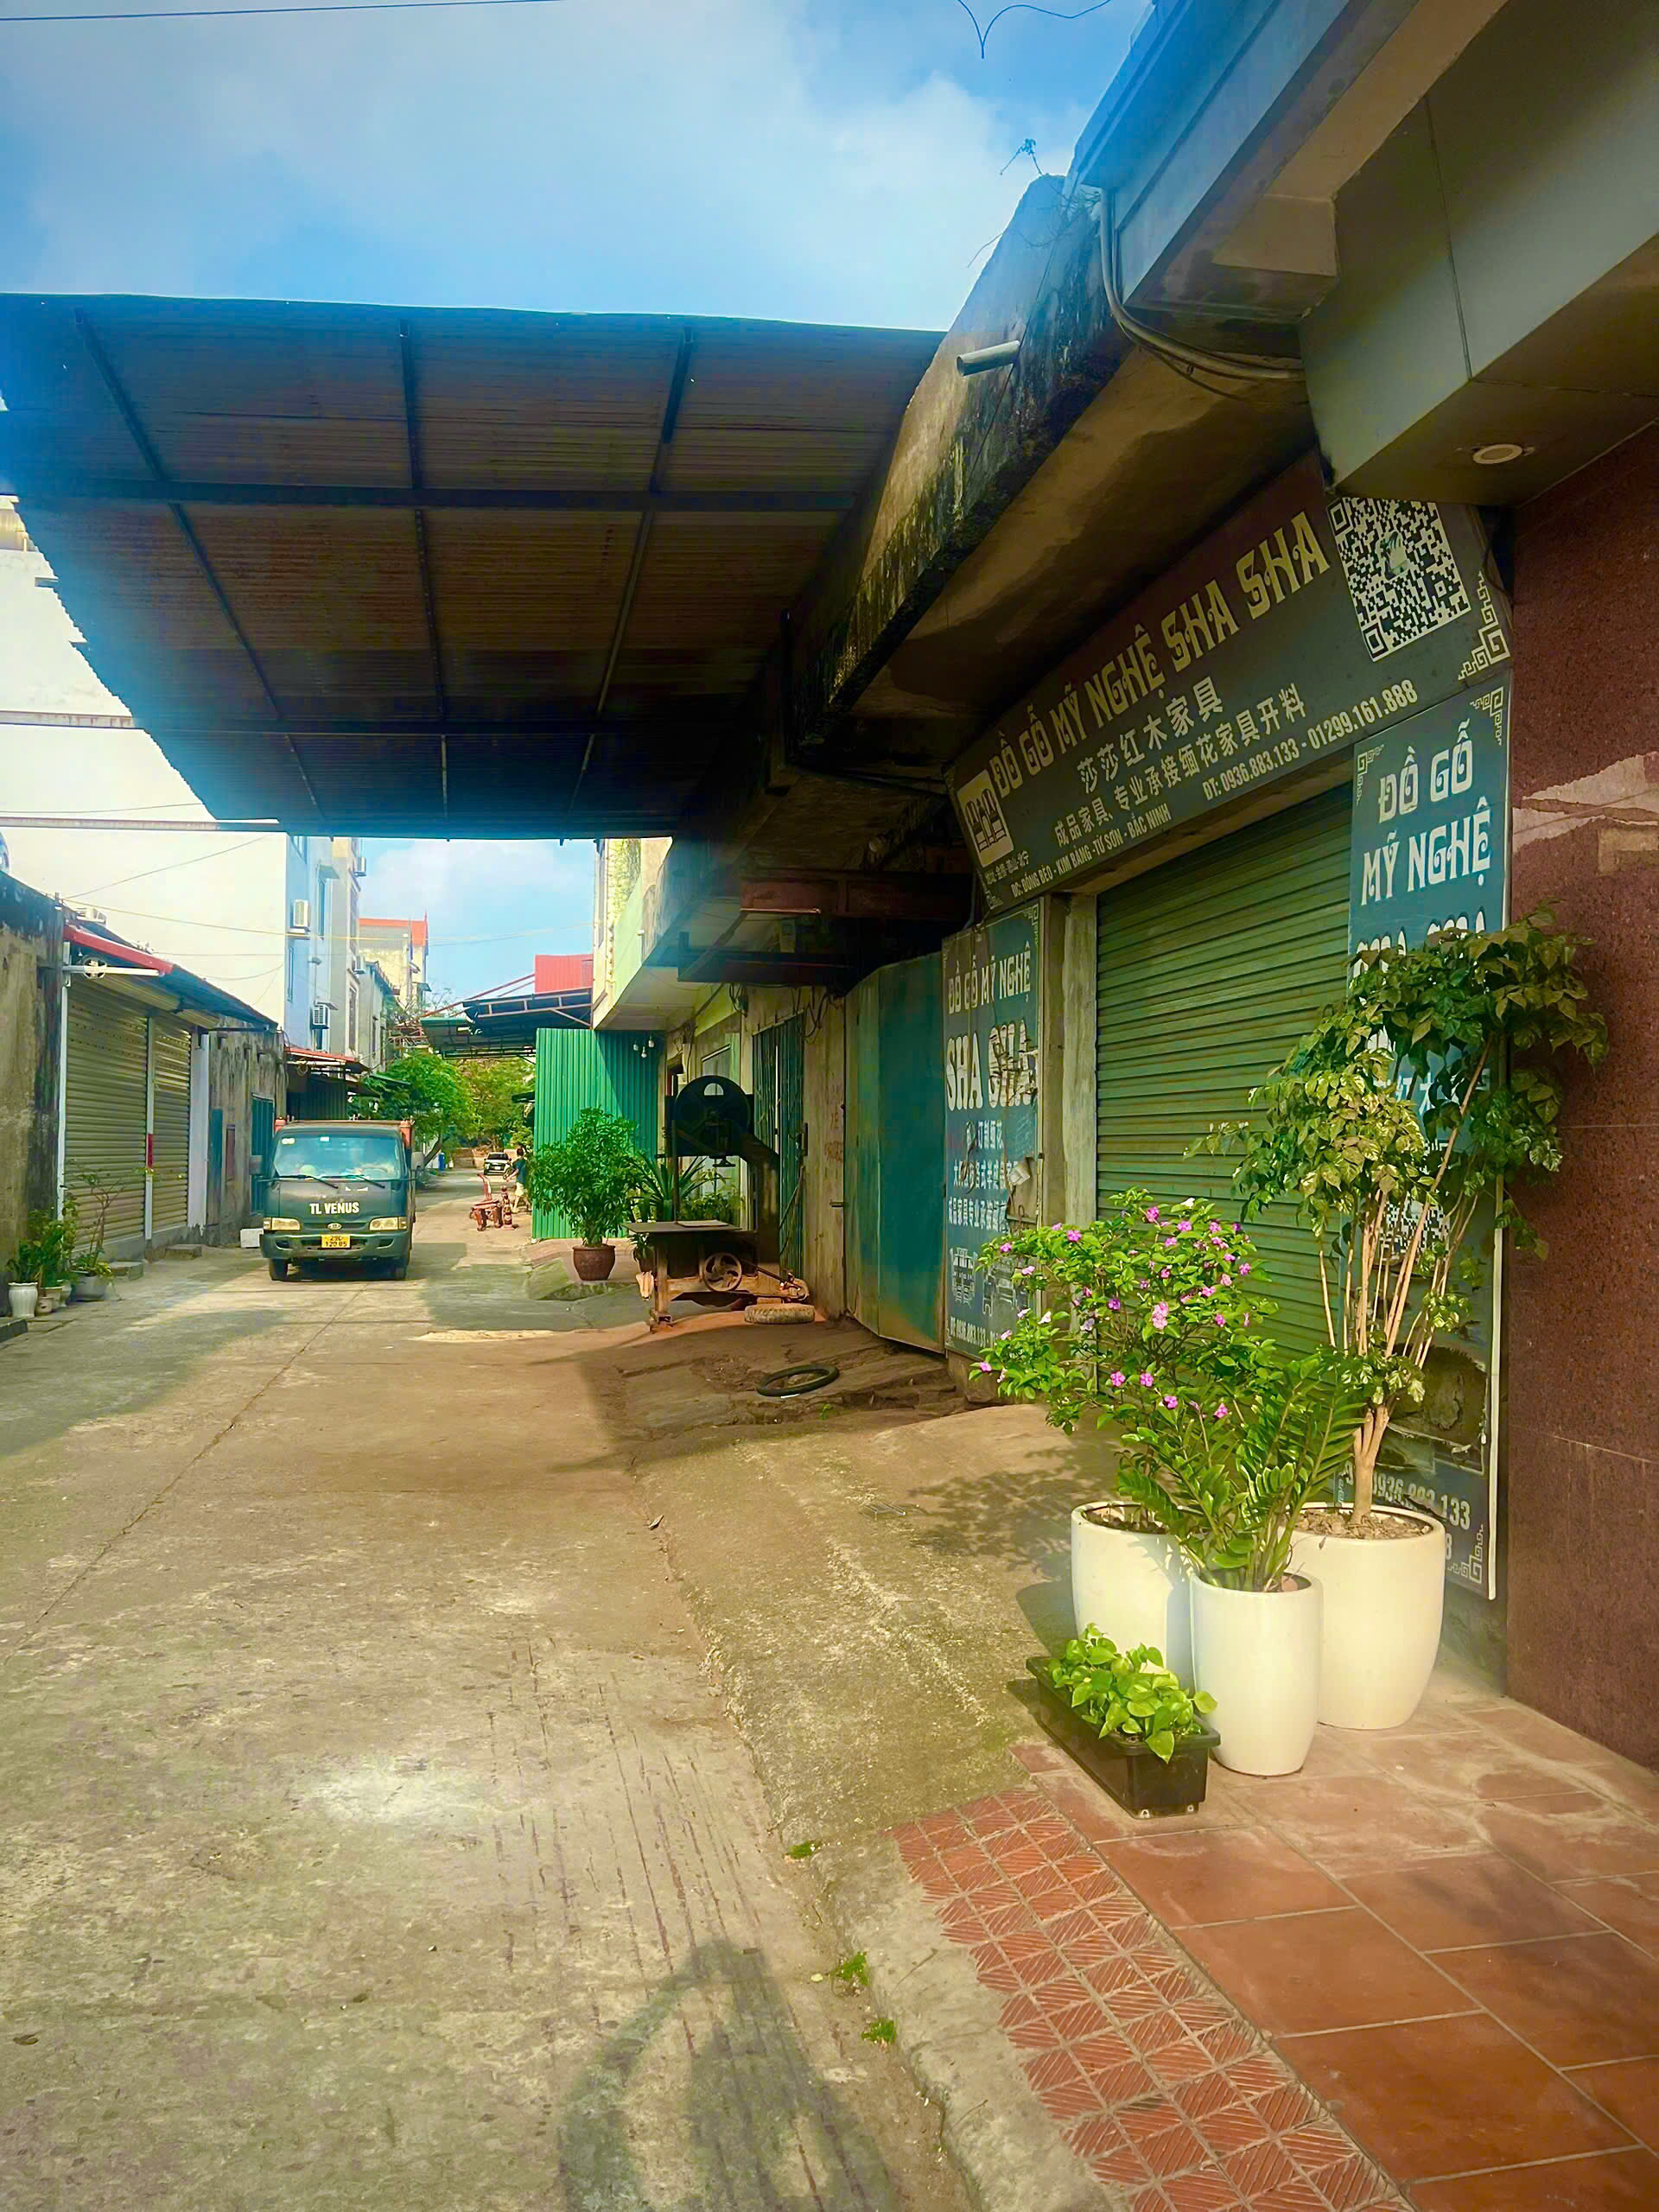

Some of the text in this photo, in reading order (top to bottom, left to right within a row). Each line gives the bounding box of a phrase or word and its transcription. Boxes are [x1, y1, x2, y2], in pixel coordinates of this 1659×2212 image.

[989, 511, 1330, 798] ĐỒ GỖ MỸ NGHỆ SHA SHA
[1077, 676, 1223, 794] 莎莎红木家具
[1114, 683, 1306, 811] 专业承接缅花家具开料
[1220, 738, 1300, 792] 0936.883.133
[1307, 679, 1418, 750] 01299.161.888
[1377, 718, 1473, 823] ĐỒ GỖ
[1056, 855, 1072, 875] KIM
[1145, 802, 1172, 830] NINH
[1361, 796, 1491, 906] MỸ NGHỆ
[949, 960, 962, 1014] ĐỒ
[999, 940, 1031, 1002] NGHỆ
[946, 1032, 983, 1111] SHA
[309, 1201, 360, 1215] TL VENUS
